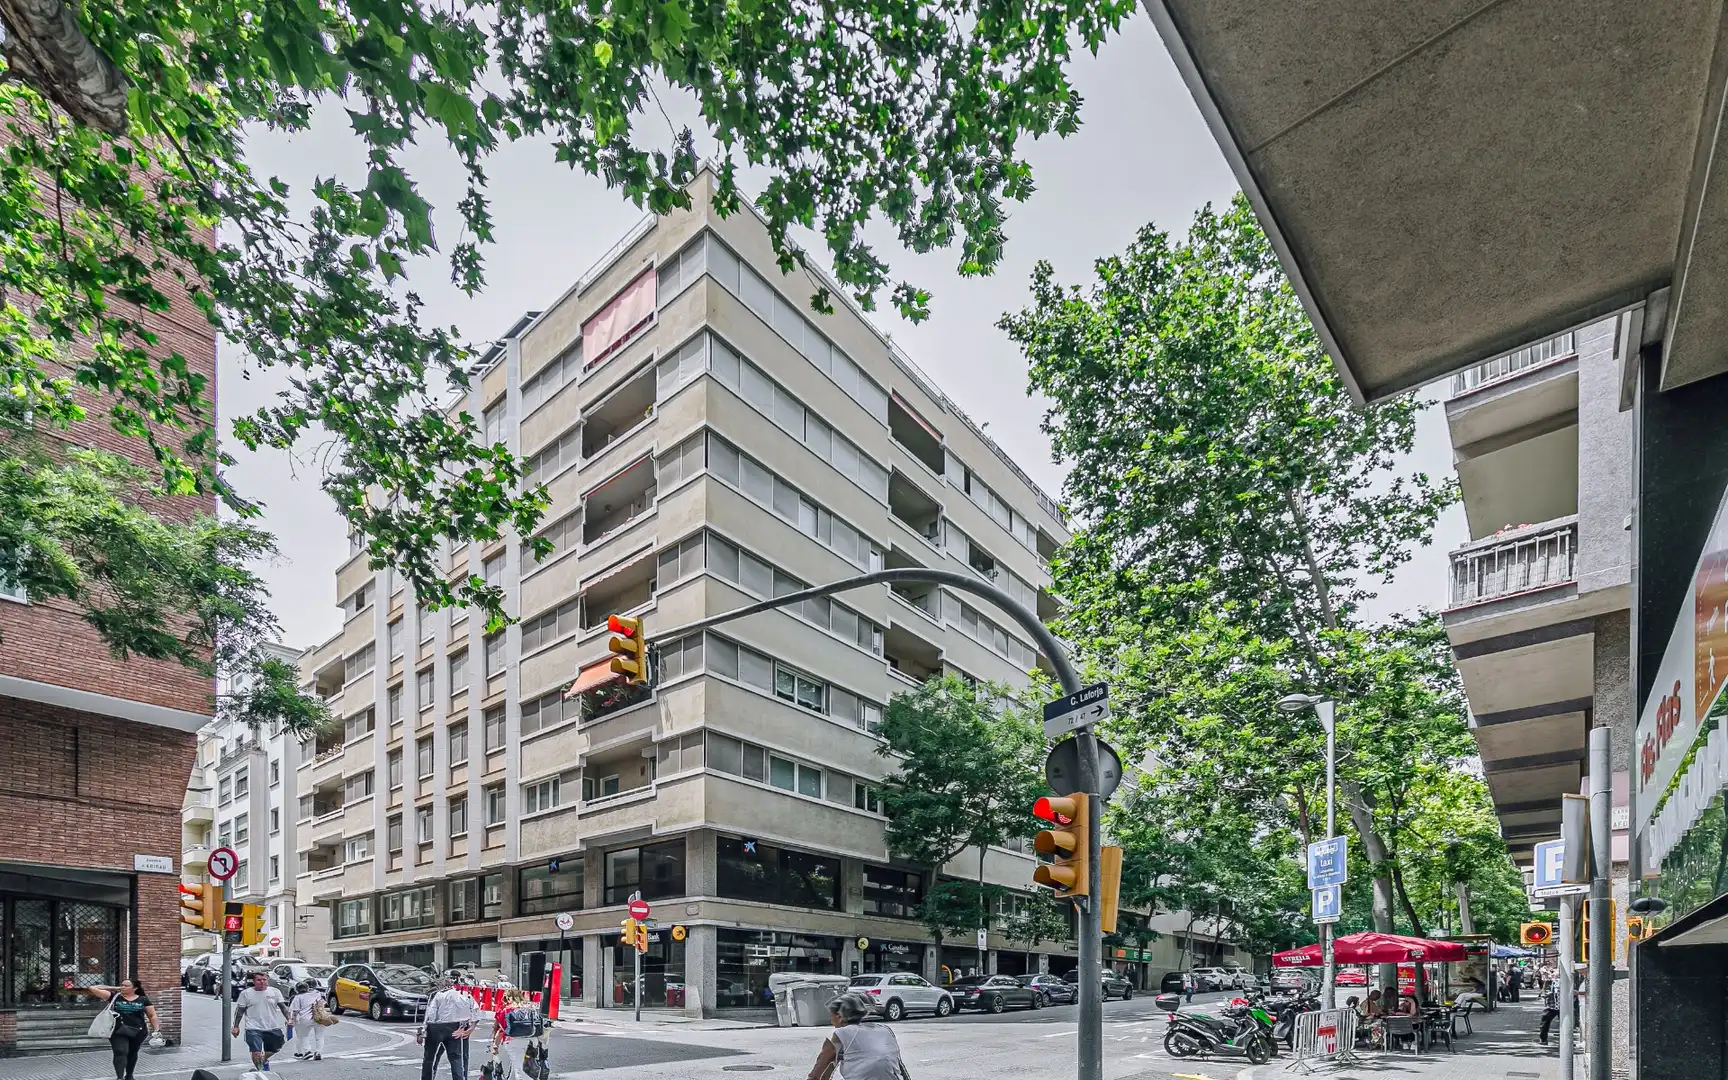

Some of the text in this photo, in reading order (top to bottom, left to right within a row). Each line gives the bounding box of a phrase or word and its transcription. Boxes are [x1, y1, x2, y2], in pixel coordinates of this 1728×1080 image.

[1070, 687, 1104, 706] C. Laforja
[1320, 857, 1333, 867] taxi
[1318, 890, 1334, 914] P
